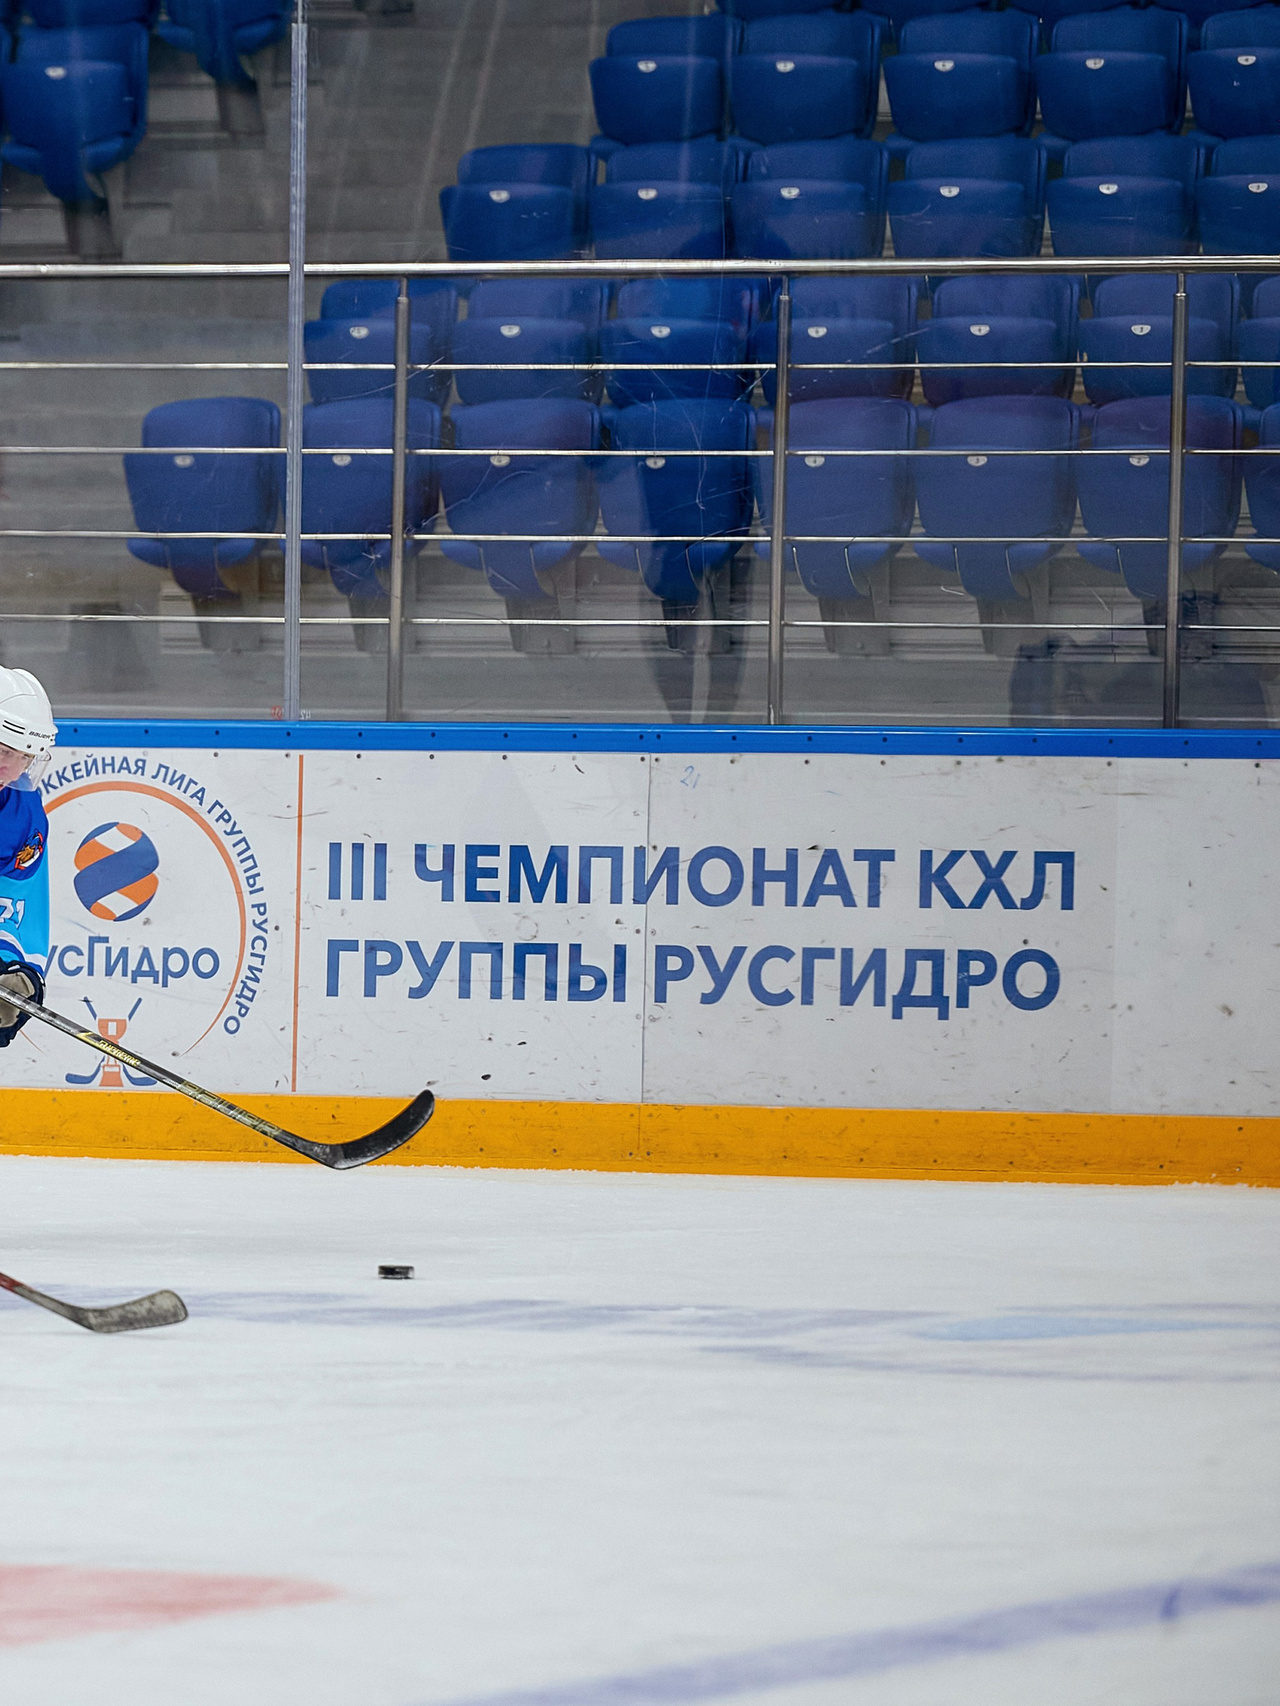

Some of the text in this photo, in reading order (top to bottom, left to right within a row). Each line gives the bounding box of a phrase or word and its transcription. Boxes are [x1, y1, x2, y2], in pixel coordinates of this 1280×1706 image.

[38, 753, 270, 1036] ККЕЙНАЯ ЛИГА ГРУППЫ РУСГИДРО
[414, 843, 896, 908] ЧЕМПИОНАТ
[919, 849, 1076, 911] КХЛ
[44, 935, 221, 988] усГидро
[326, 939, 1061, 1021] ГРУППЫ РУСГИДРО
